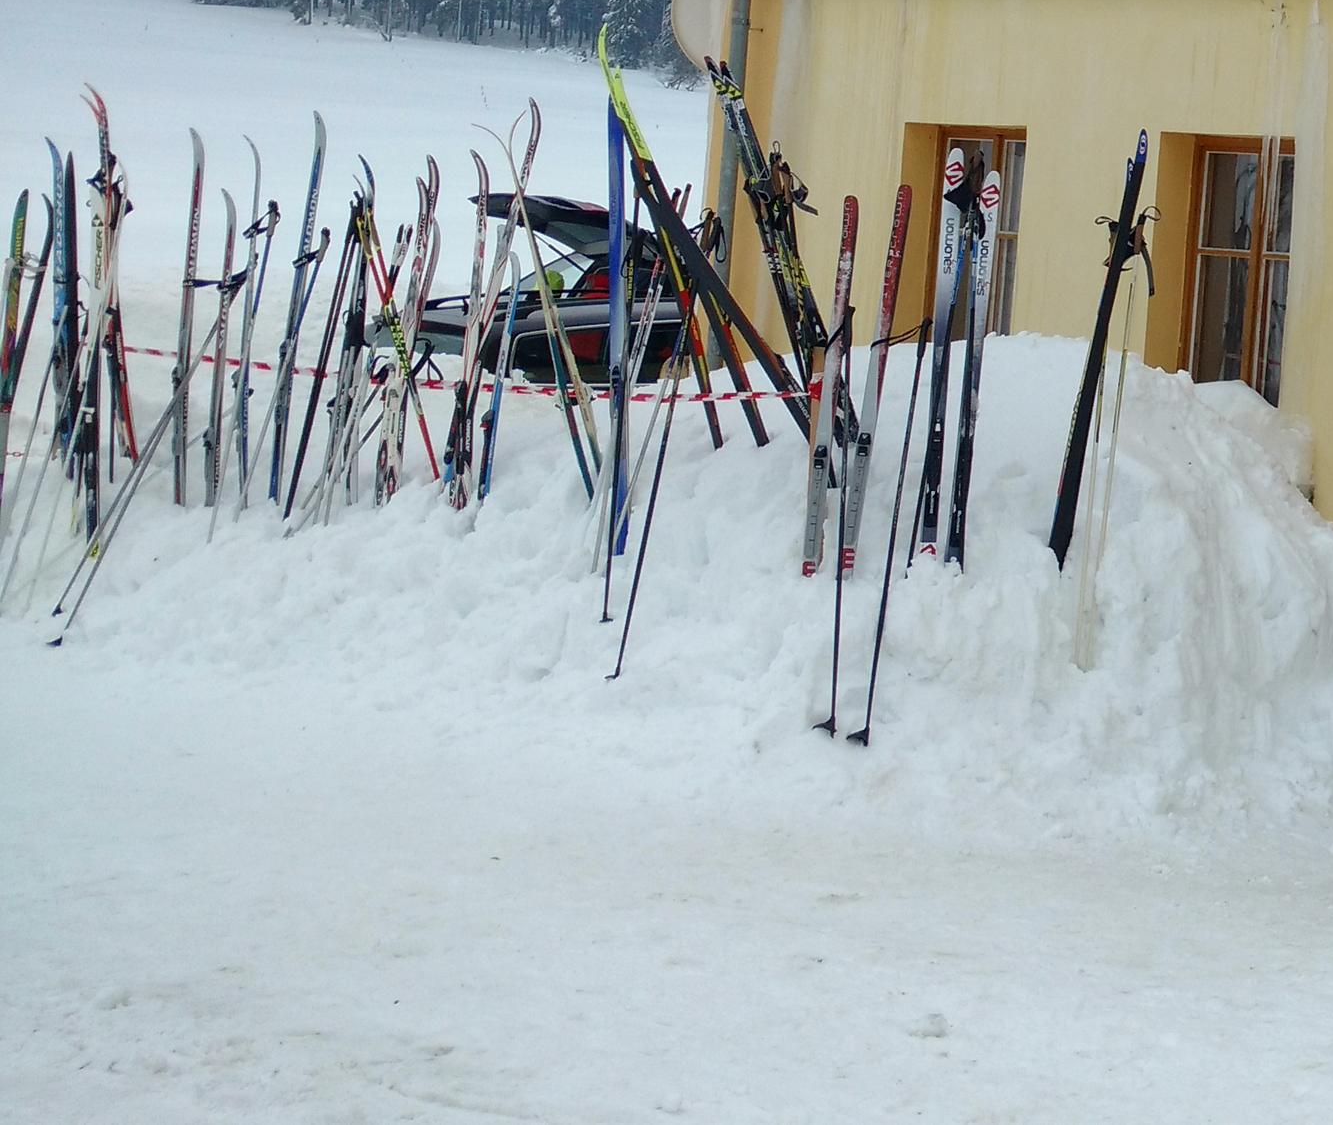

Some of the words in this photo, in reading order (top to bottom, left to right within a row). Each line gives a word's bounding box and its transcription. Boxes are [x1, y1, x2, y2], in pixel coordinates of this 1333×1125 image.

[94, 230, 104, 290] FISCHER
[943, 217, 955, 275] salomon
[977, 239, 989, 296] salomon
[217, 268, 231, 349] SALOMN
